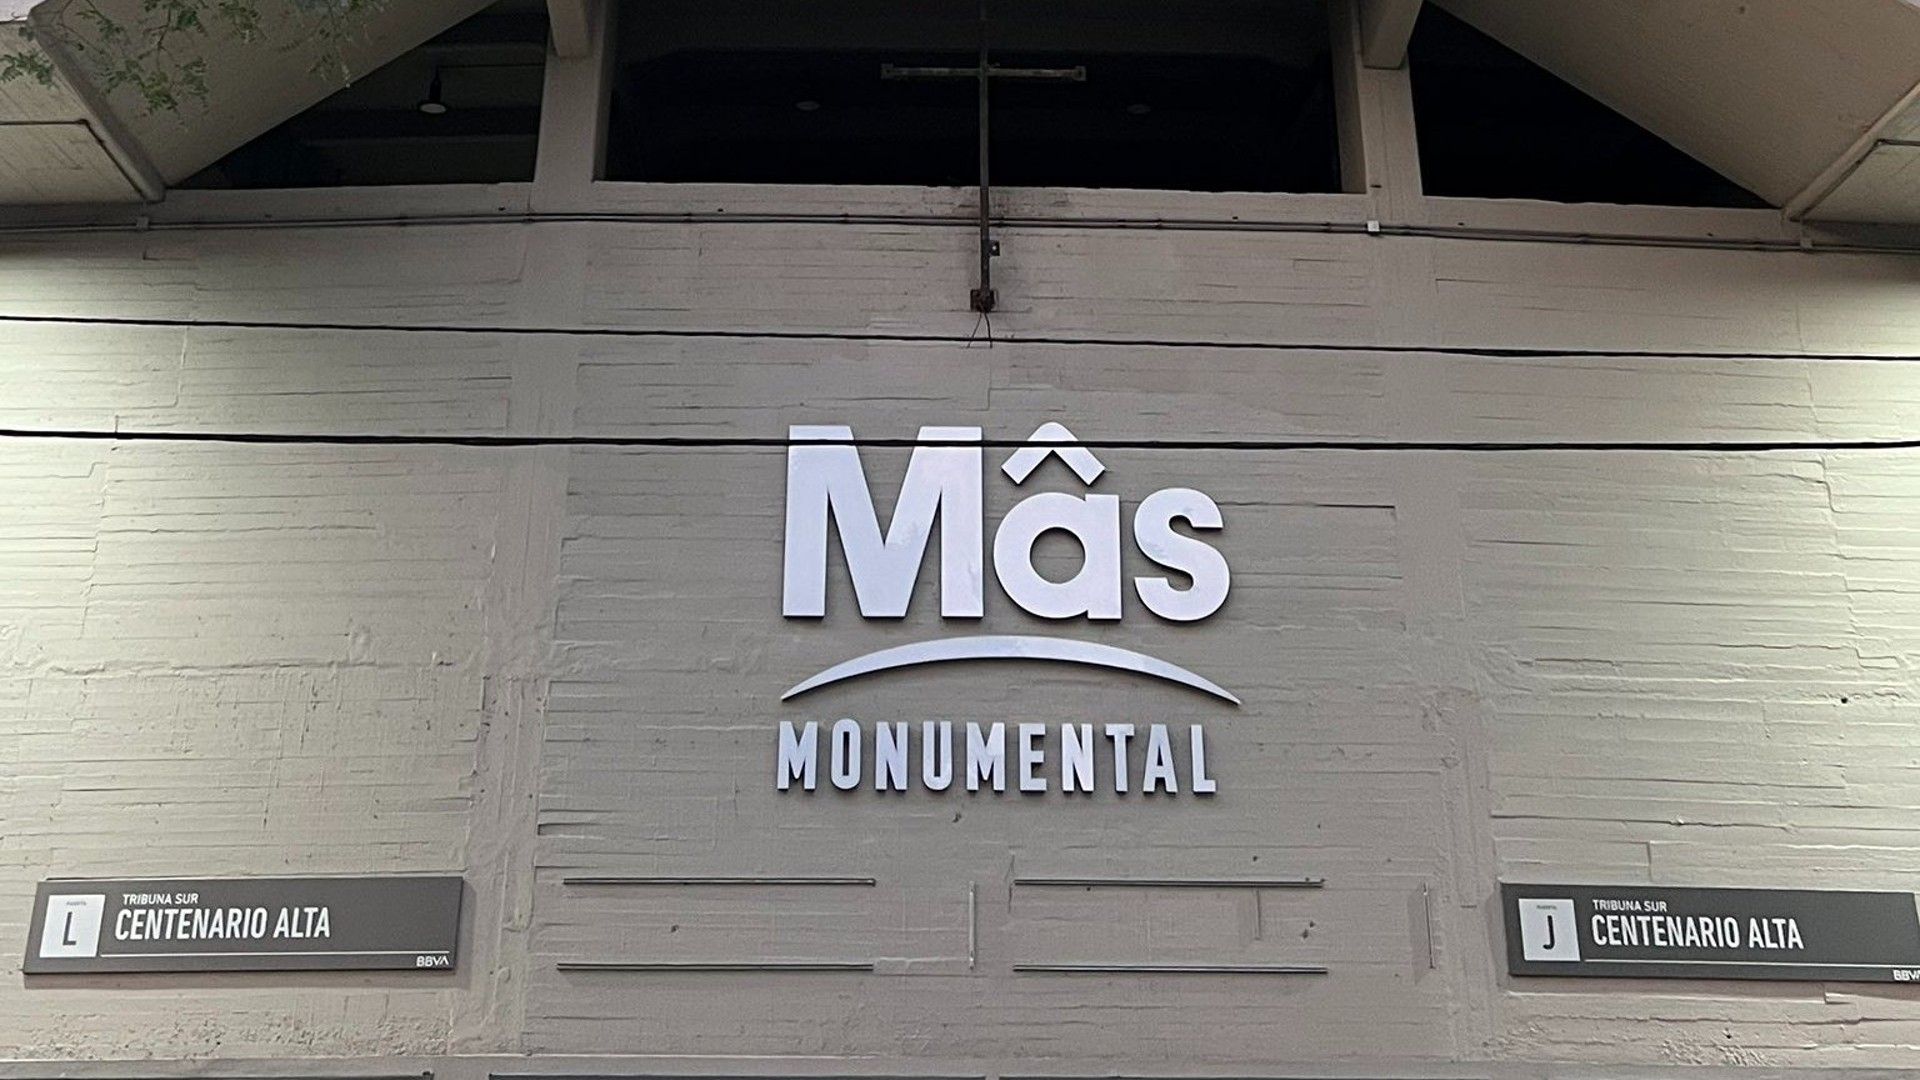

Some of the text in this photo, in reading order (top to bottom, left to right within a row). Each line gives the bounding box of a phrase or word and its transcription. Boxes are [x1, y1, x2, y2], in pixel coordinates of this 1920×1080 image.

[782, 422, 1231, 621] Mâs
[777, 718, 1217, 794] MONUMENTAL
[122, 893, 199, 905] TRIBUNA SUR
[1592, 899, 1667, 912] TRIBUNA SUR
[62, 911, 77, 945] L
[115, 907, 331, 940] CENTENARIO ALTA
[1542, 915, 1555, 950] J
[1592, 914, 1804, 949] CENTENARIO ALTA
[416, 955, 449, 967] BBVA
